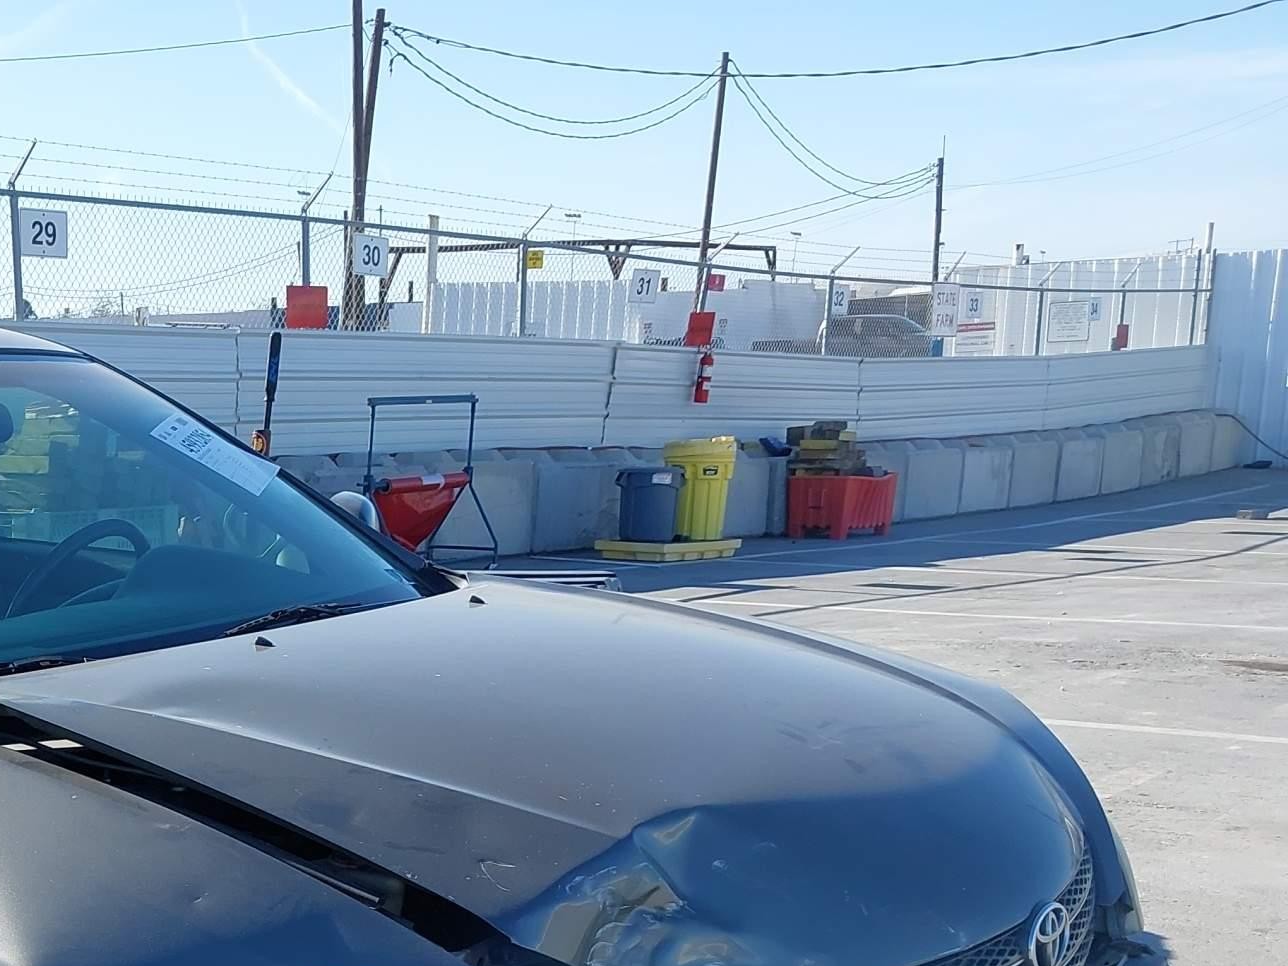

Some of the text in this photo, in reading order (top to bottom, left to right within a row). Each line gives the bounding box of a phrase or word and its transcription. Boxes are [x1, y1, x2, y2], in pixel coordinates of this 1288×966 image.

[31, 220, 57, 247] 29
[362, 244, 381, 267] 30
[636, 276, 652, 296] 31
[833, 290, 845, 307] 32
[936, 291, 957, 307] STATE
[968, 297, 979, 313] 33
[1090, 302, 1099, 316] 34
